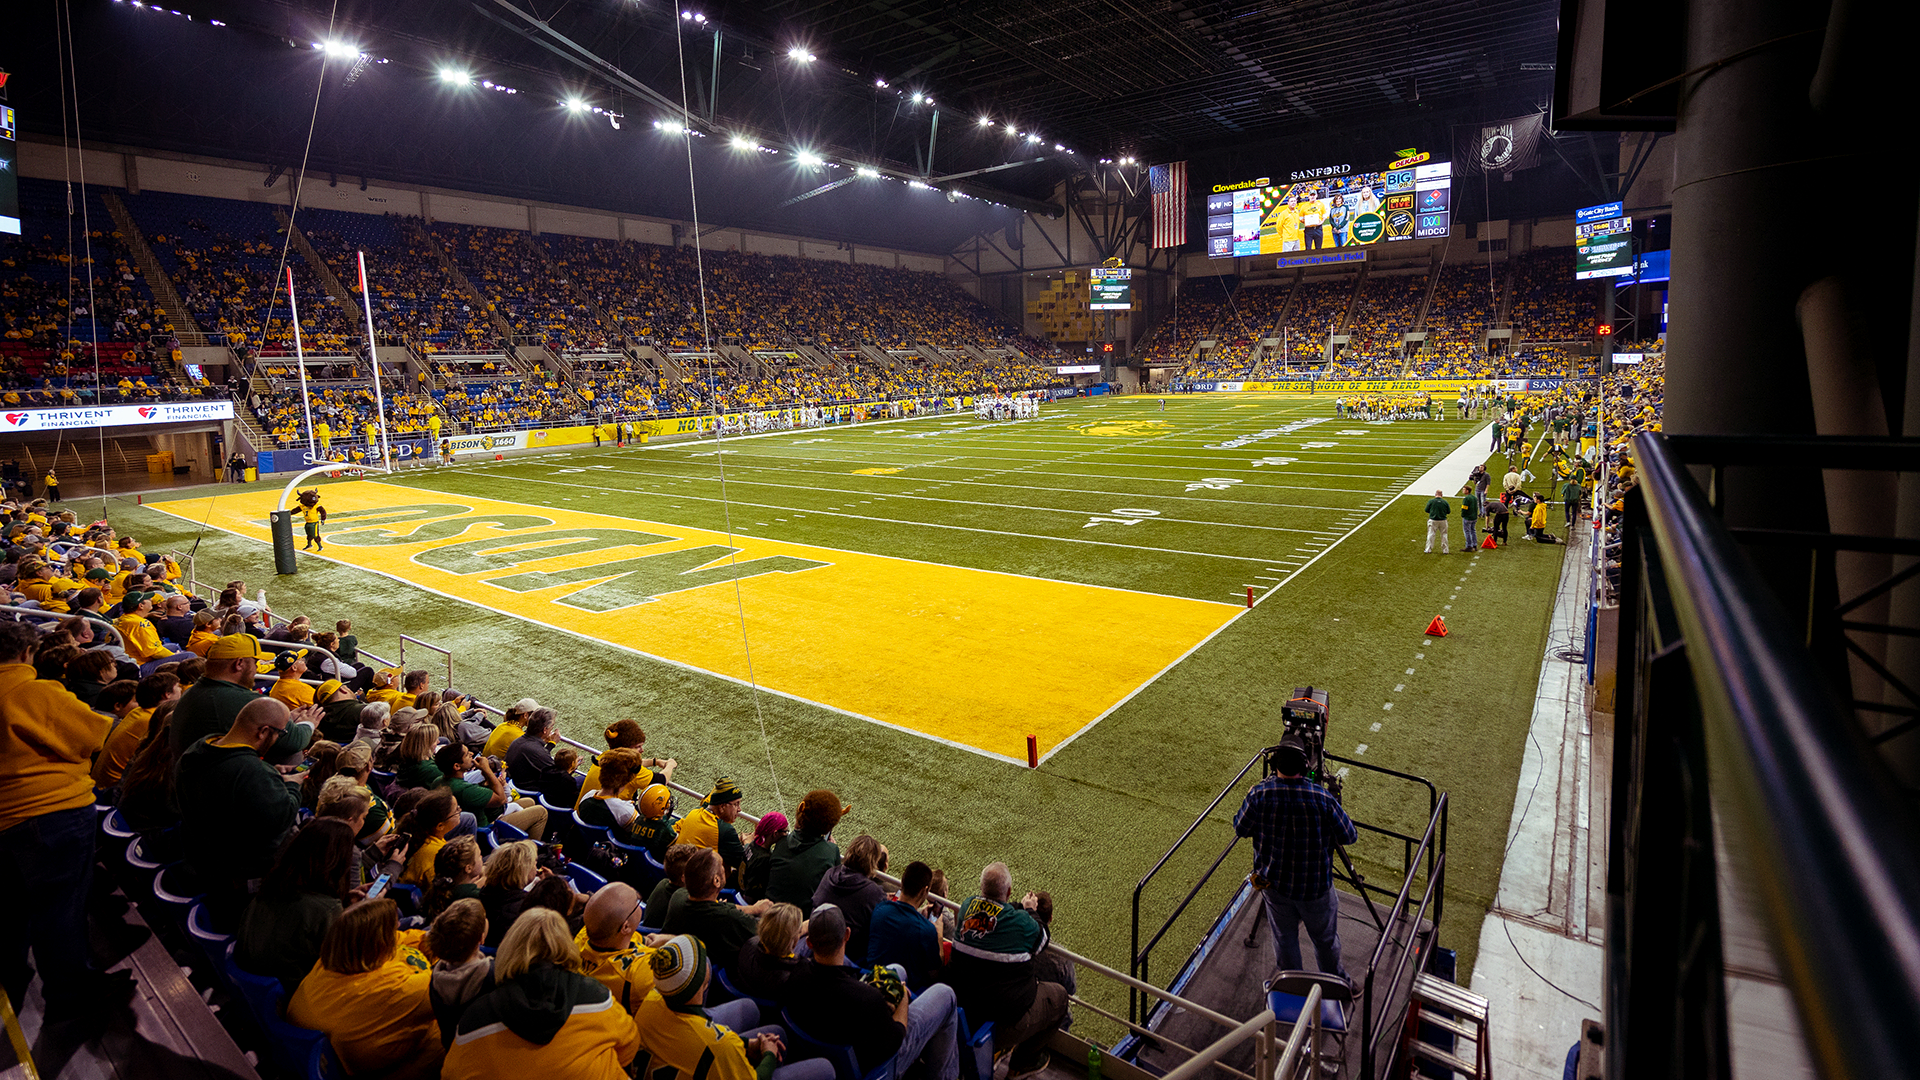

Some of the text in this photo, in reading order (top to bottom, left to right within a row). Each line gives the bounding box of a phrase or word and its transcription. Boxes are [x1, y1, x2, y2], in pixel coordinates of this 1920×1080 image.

[1395, 154, 1424, 168] DEKALB
[1291, 164, 1351, 180] SANFORD
[1387, 171, 1412, 186] BIG
[1213, 180, 1256, 193] Cloverdale
[1390, 201, 1410, 209] LIVE
[1594, 207, 1604, 215] City
[1604, 204, 1620, 213] Bank
[1418, 228, 1445, 237] MIDCO
[1306, 257, 1321, 265] City
[1322, 254, 1342, 263] Bank
[1344, 251, 1364, 260] Field
[1599, 325, 1611, 335] 25
[1104, 344, 1113, 352] 25
[1272, 382, 1291, 390] THE
[1348, 382, 1361, 390] OF
[1366, 382, 1388, 390] THE
[1391, 382, 1420, 390] HERD
[37, 404, 226, 420] THRIVENT THRIVENT
[450, 437, 515, 449] BISON 1660
[1186, 477, 1244, 491] 20
[1088, 508, 1161, 526] 10
[247, 503, 835, 613] NDSU
[966, 898, 1003, 918] BISON
